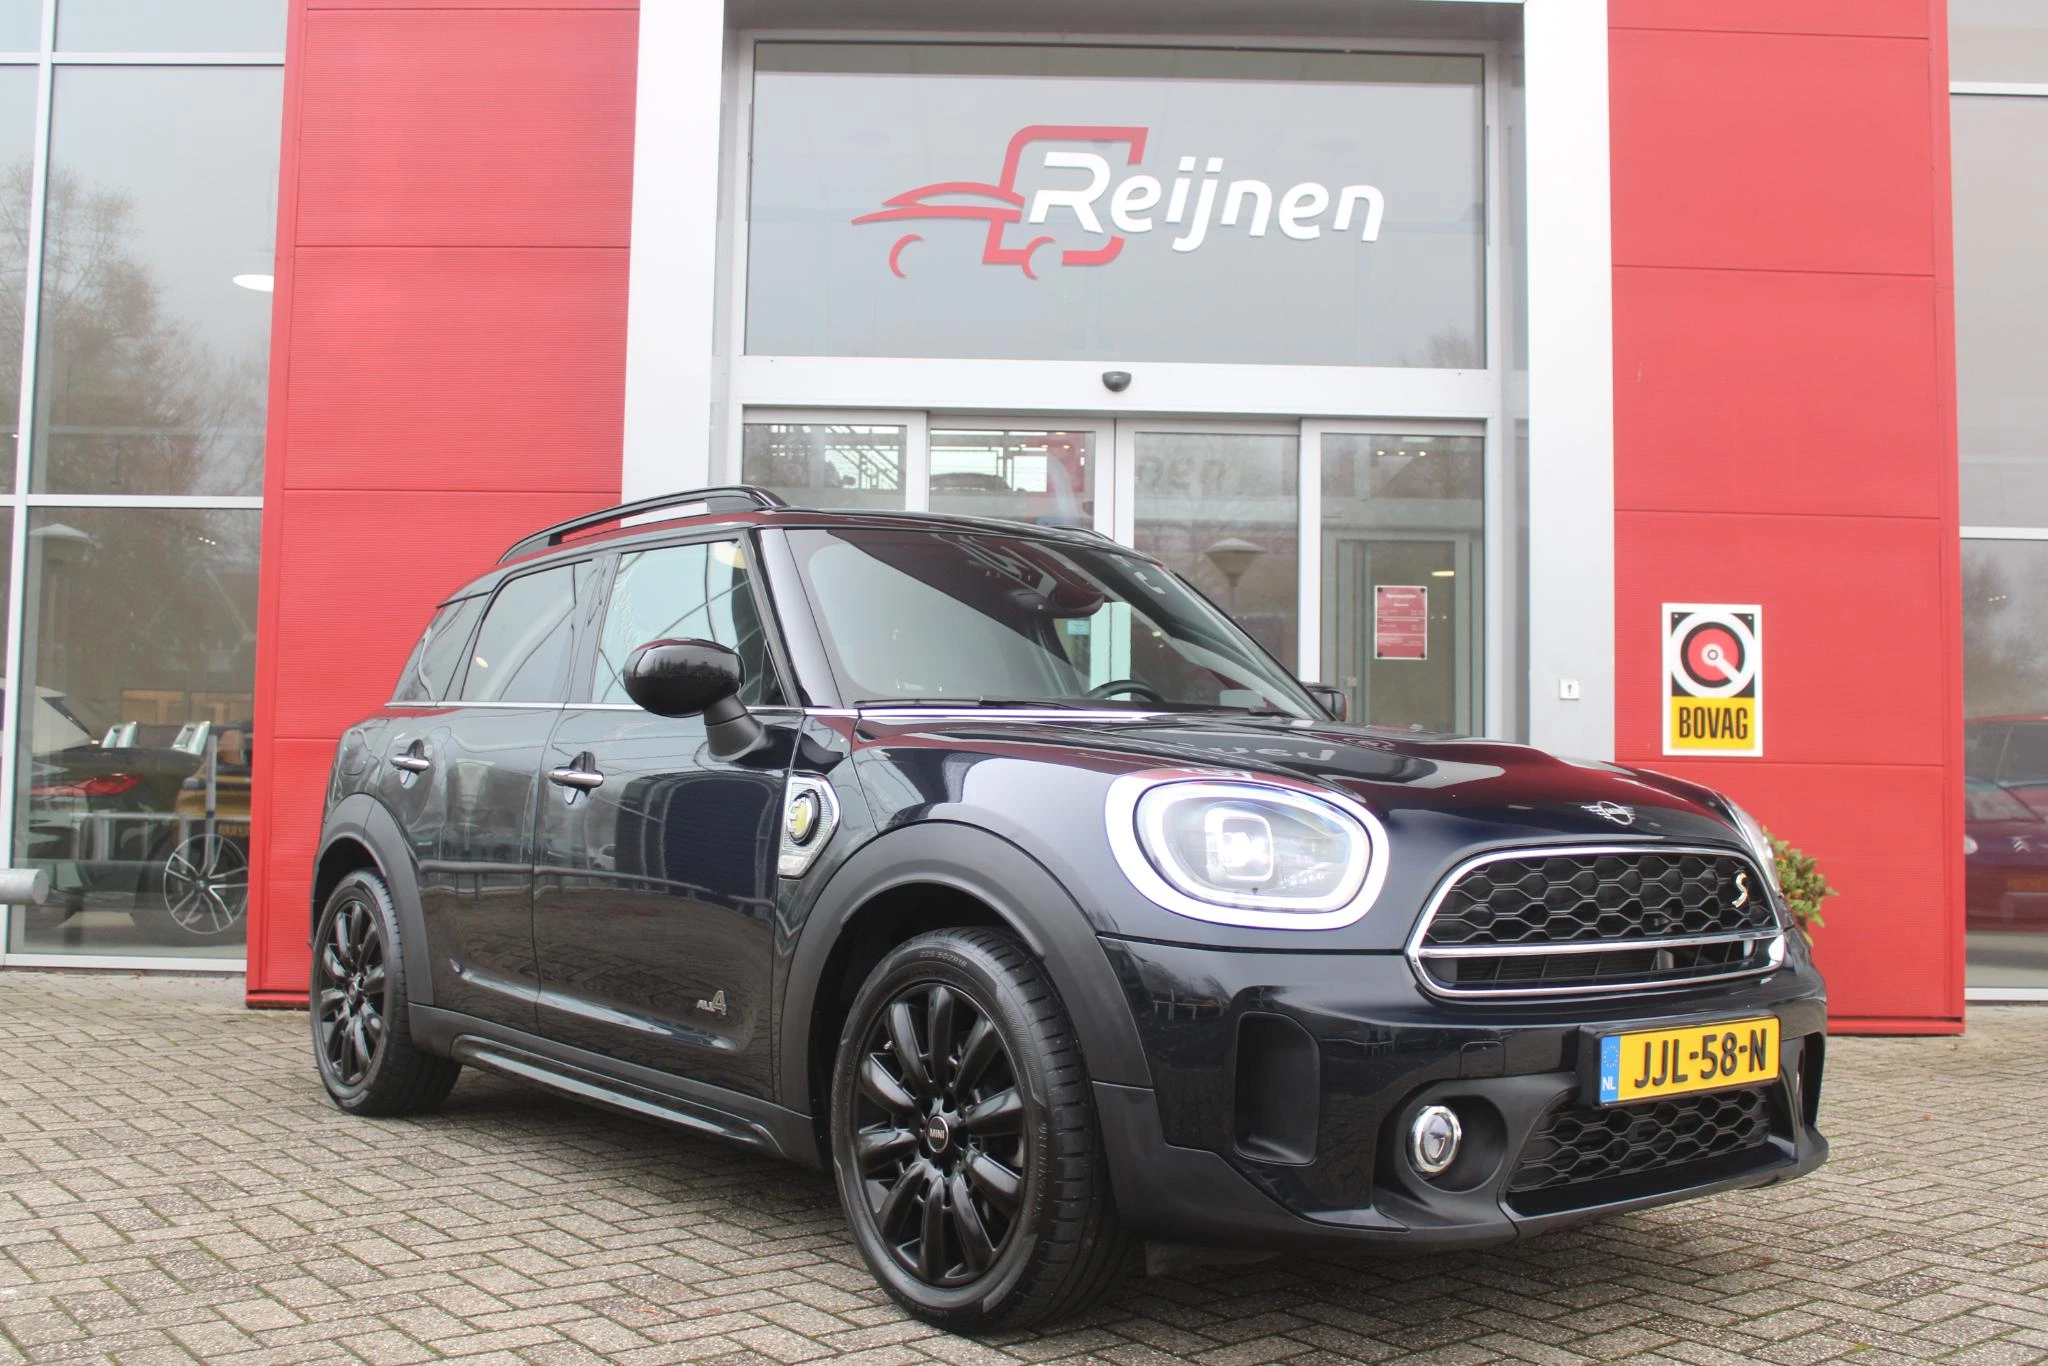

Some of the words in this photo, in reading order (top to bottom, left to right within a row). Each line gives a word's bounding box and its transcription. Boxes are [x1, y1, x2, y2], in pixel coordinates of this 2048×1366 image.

[1028, 151, 1385, 253] Reijnen
[1679, 706, 1748, 740] BOVAG
[1732, 872, 1748, 908] S
[1635, 1028, 1767, 1089] JJL-58-N
[1602, 1076, 1617, 1091] NL
[929, 1127, 945, 1139] MINI
